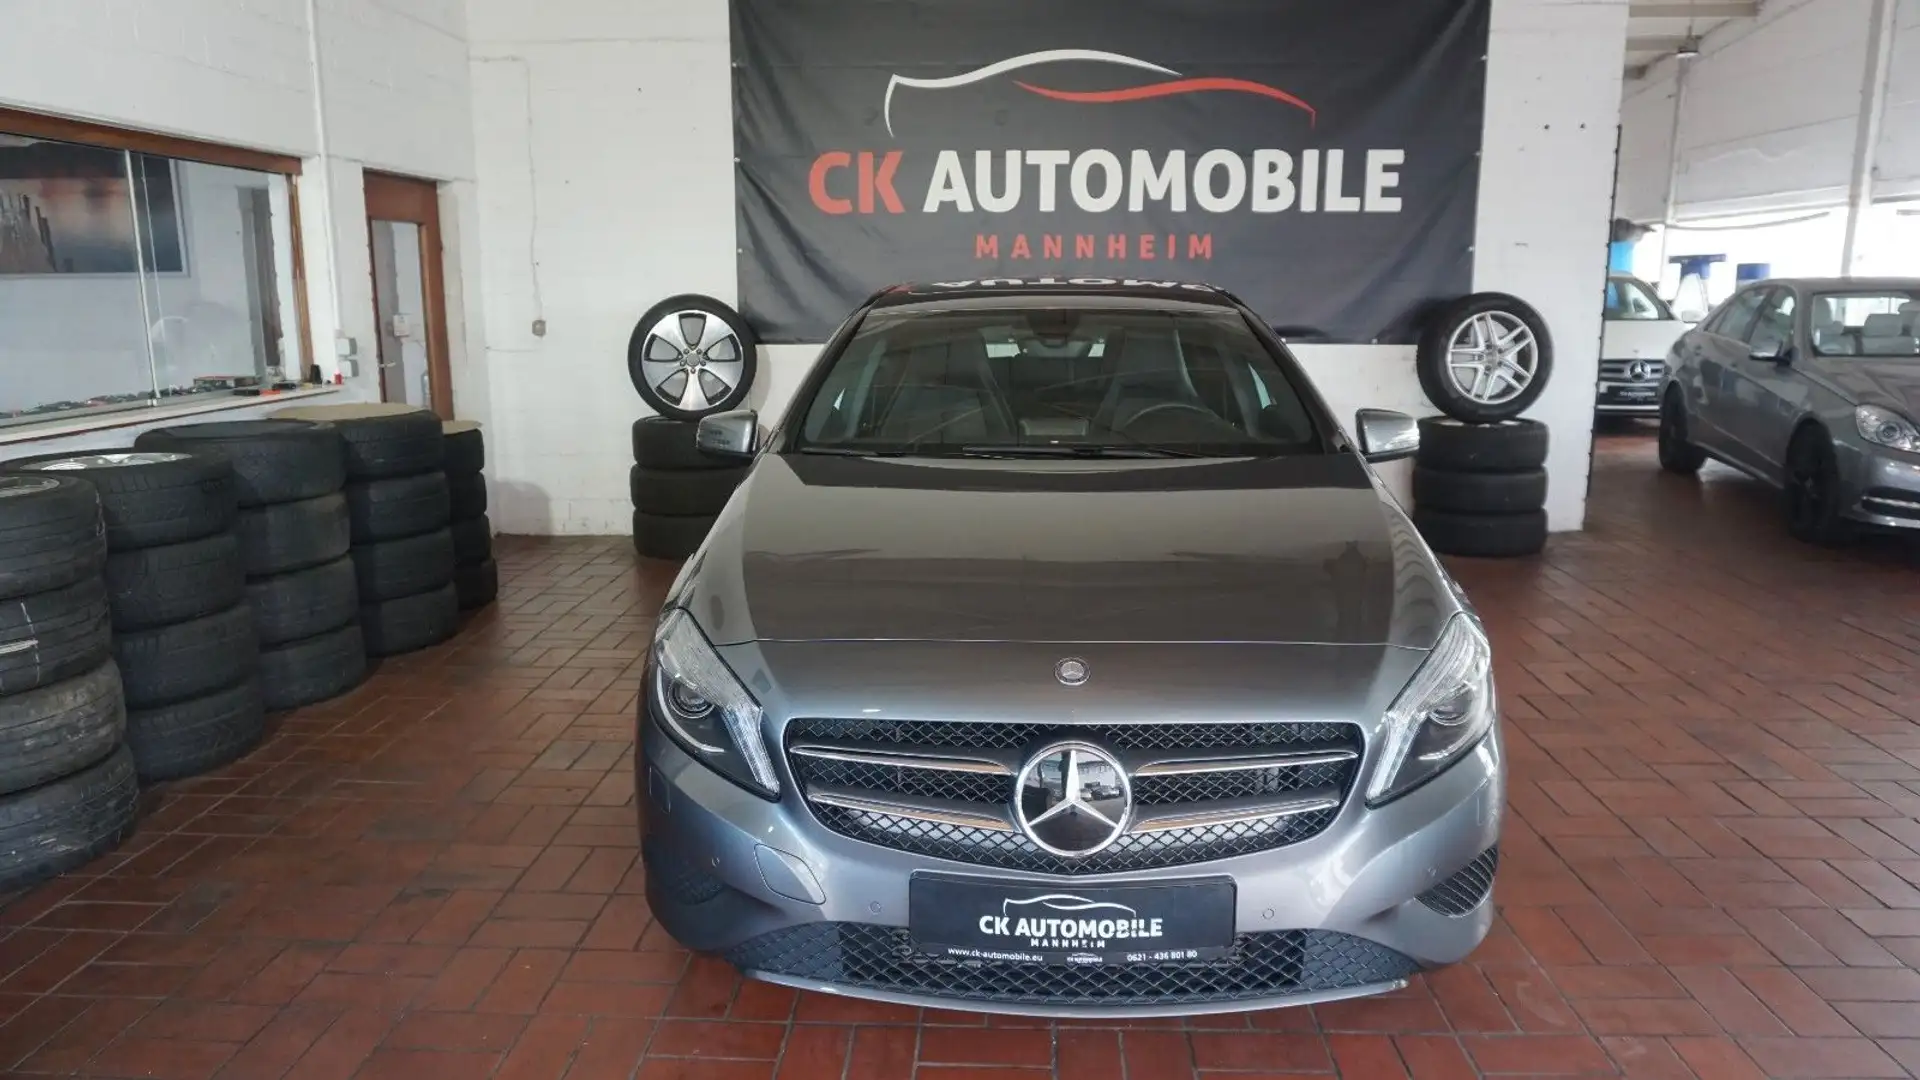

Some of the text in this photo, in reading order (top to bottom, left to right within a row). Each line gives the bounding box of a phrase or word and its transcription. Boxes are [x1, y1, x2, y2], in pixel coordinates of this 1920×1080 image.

[809, 149, 1405, 214] CK AUTOMOBILE
[974, 234, 1213, 259] MANNHEIM
[979, 915, 1163, 939] CK AUTOMOBILE
[1030, 938, 1105, 948] MANNHEIM
[948, 948, 1043, 961] www.ck-automobile.eu
[1127, 953, 1146, 962] 0621
